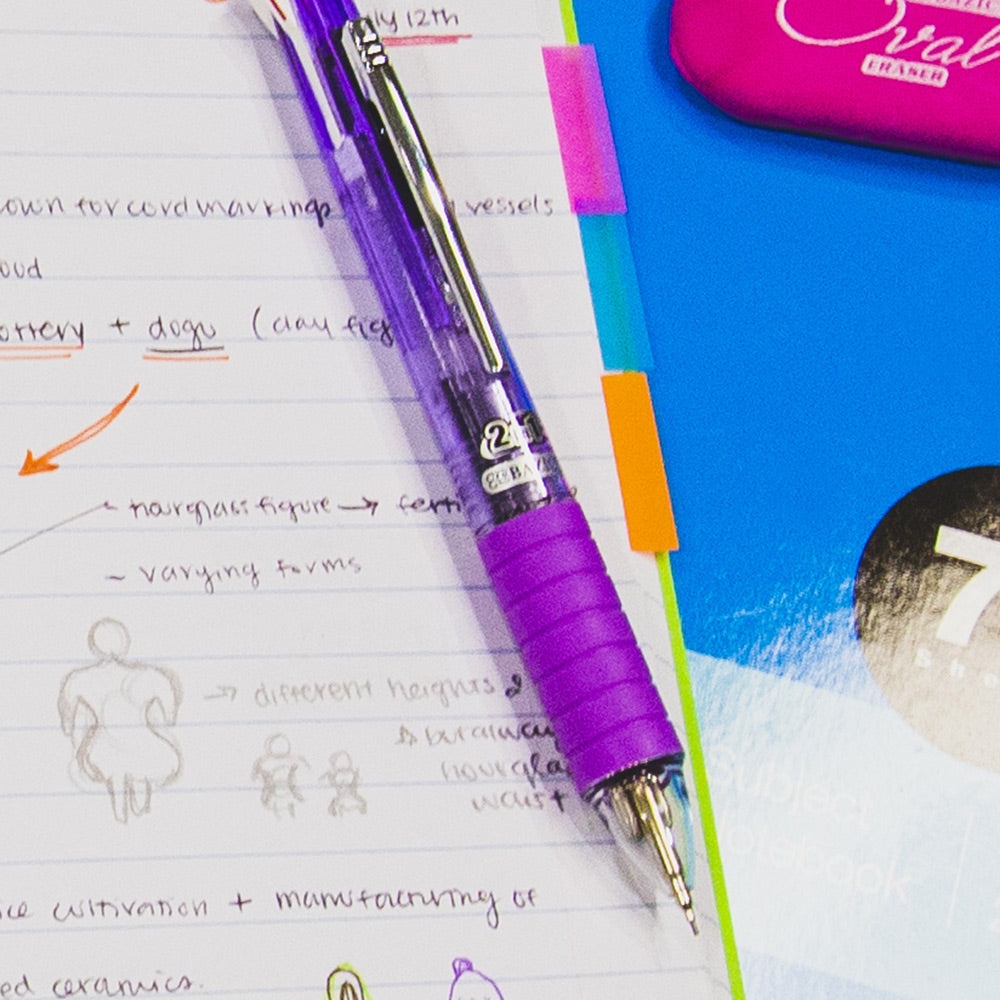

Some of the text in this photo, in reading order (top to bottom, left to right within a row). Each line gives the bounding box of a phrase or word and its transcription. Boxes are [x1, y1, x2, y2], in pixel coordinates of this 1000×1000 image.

[865, 56, 947, 84] ERASER
[464, 193, 554, 217] vessels
[138, 562, 261, 595] varying
